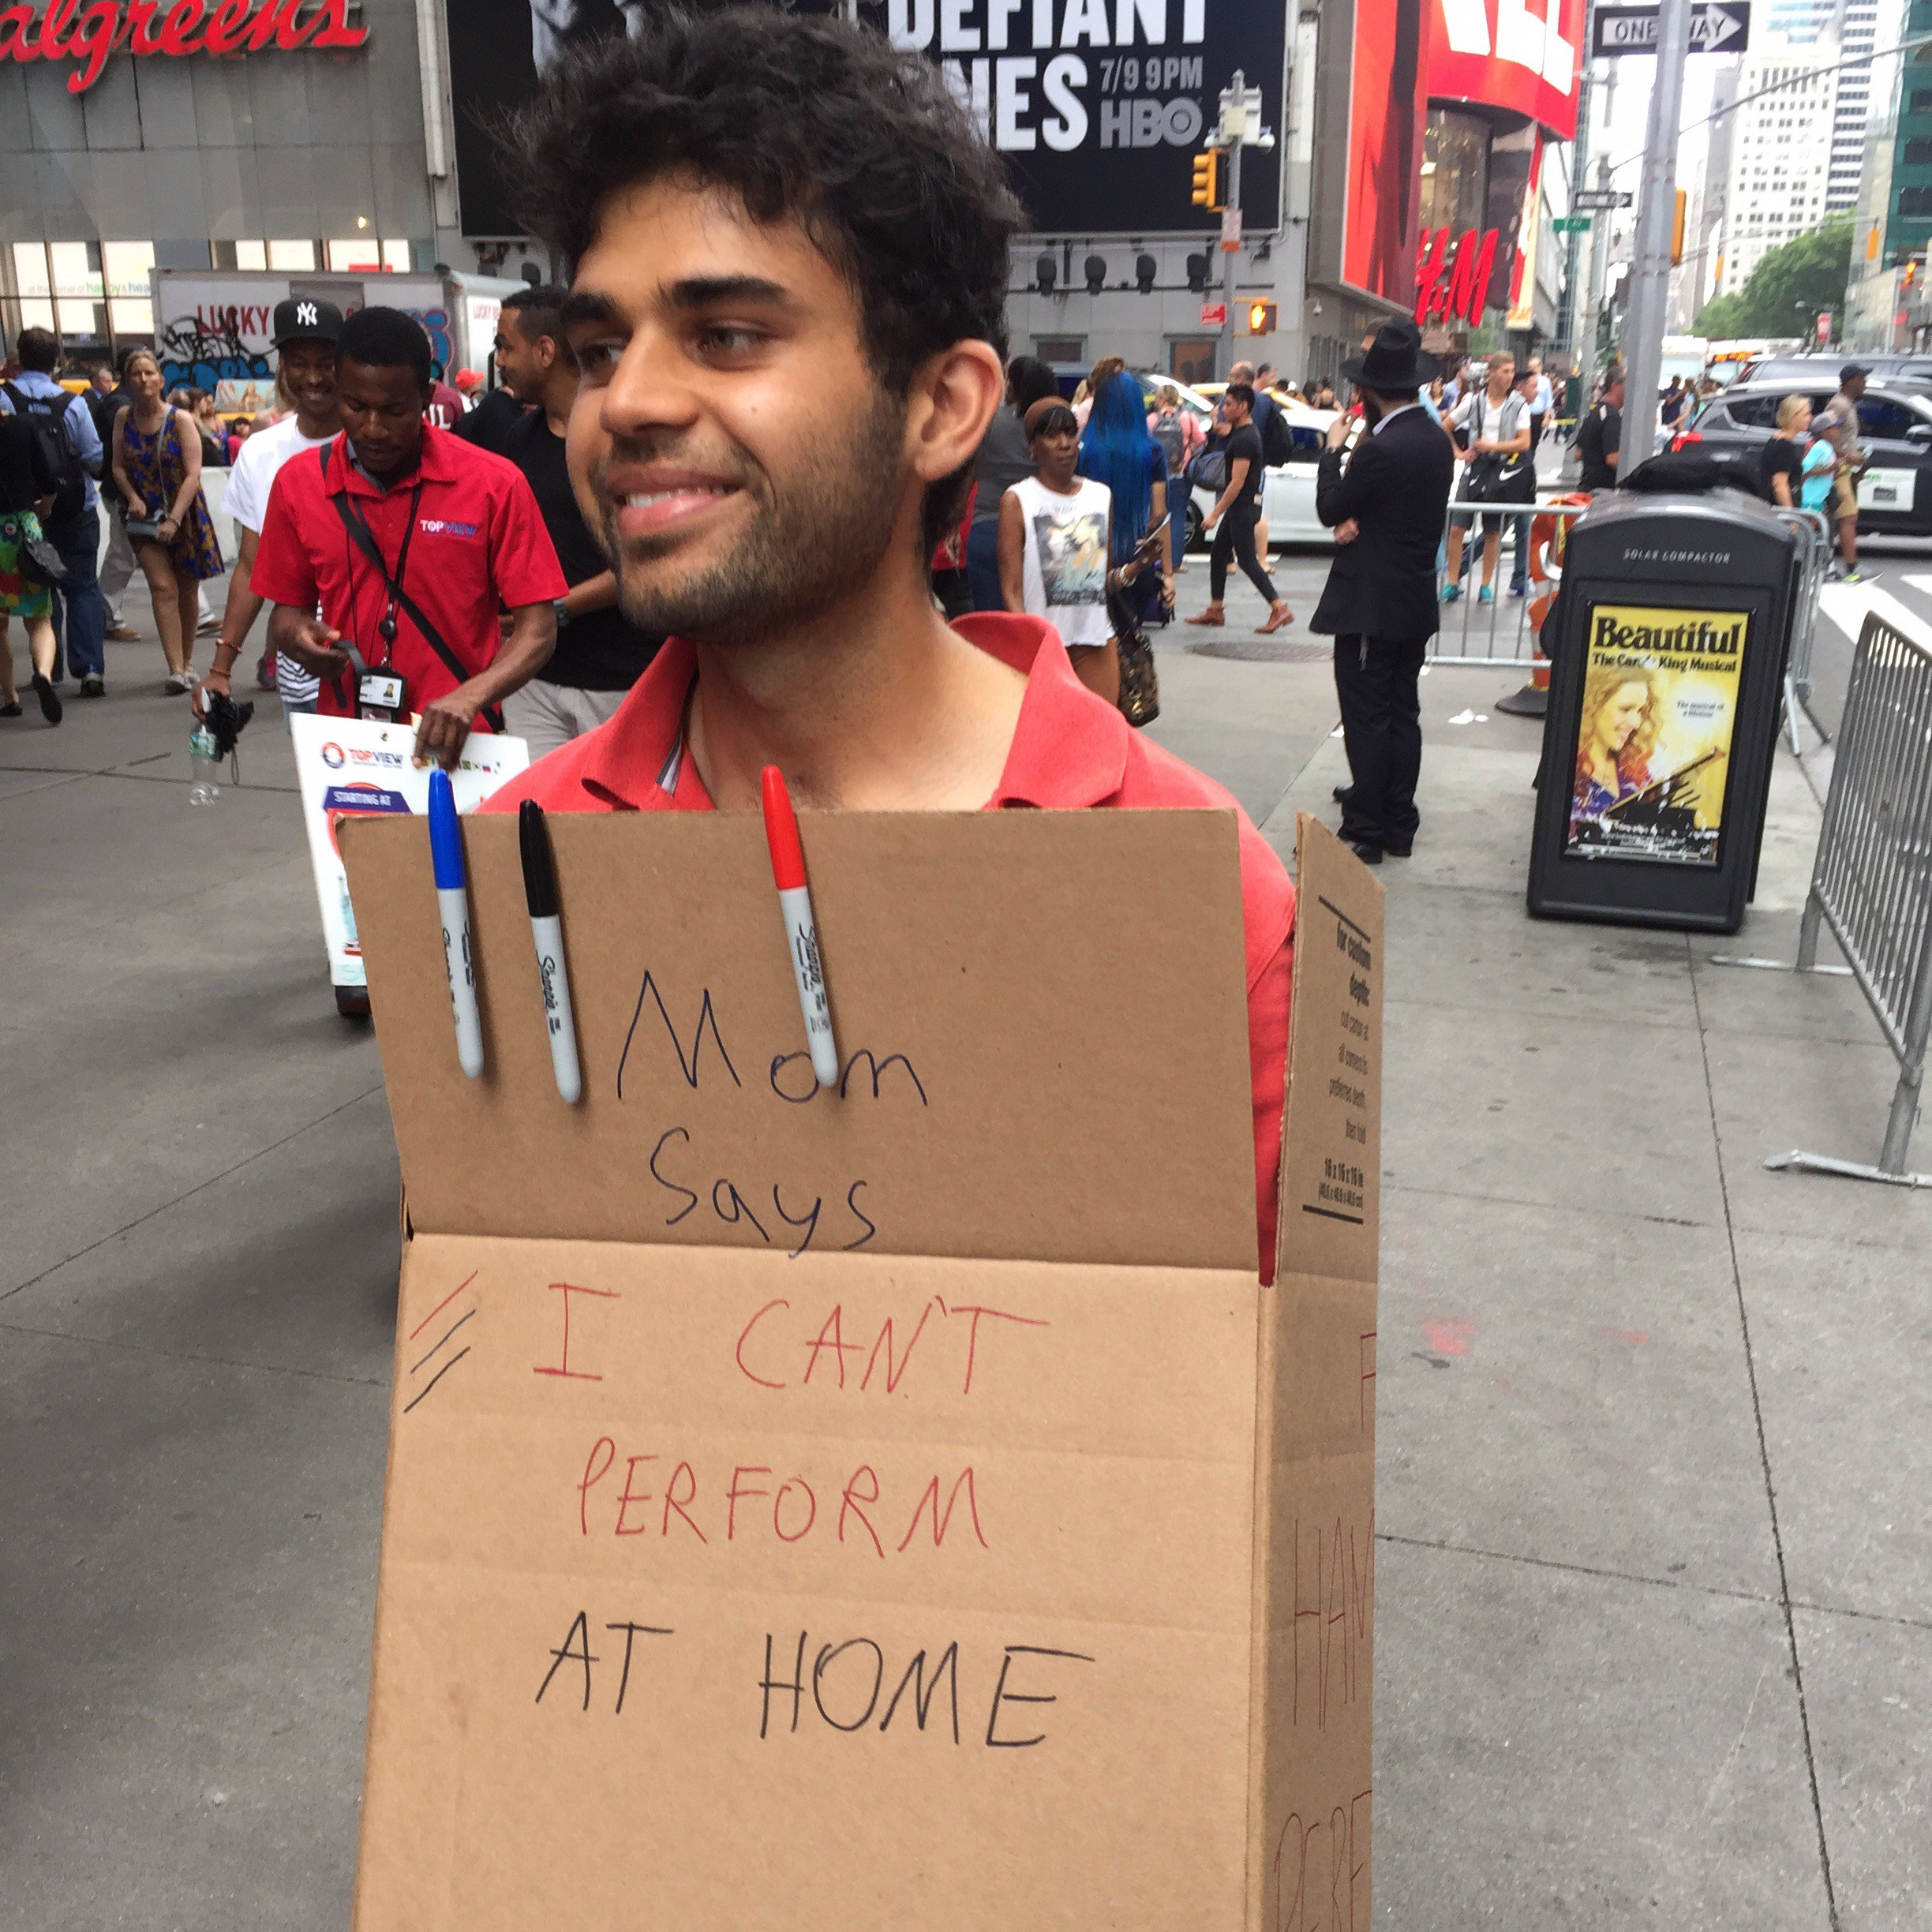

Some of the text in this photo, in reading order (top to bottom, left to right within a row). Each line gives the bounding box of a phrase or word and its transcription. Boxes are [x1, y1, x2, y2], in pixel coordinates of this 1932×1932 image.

[1100, 55, 1204, 94] 7/9 9PM
[1100, 97, 1203, 149] HBO
[197, 304, 271, 336] LUCKY
[297, 301, 317, 326] NY
[420, 519, 477, 536] TOPVIEW
[1623, 548, 1731, 564] SOLAR COMPACTOR
[1593, 615, 1743, 654] Beautiful
[1592, 651, 1616, 666] The
[1658, 654, 1689, 672] King
[1690, 657, 1738, 672] Musical
[348, 747, 404, 765] TOPVIEW
[332, 790, 392, 807] STARTING AT
[616, 969, 928, 1106] Mom
[649, 1125, 877, 1260] Says
[533, 1282, 1052, 1397] I CAN'T
[577, 1436, 990, 1559] PERFORM
[535, 1610, 1096, 1747] AT HOME
